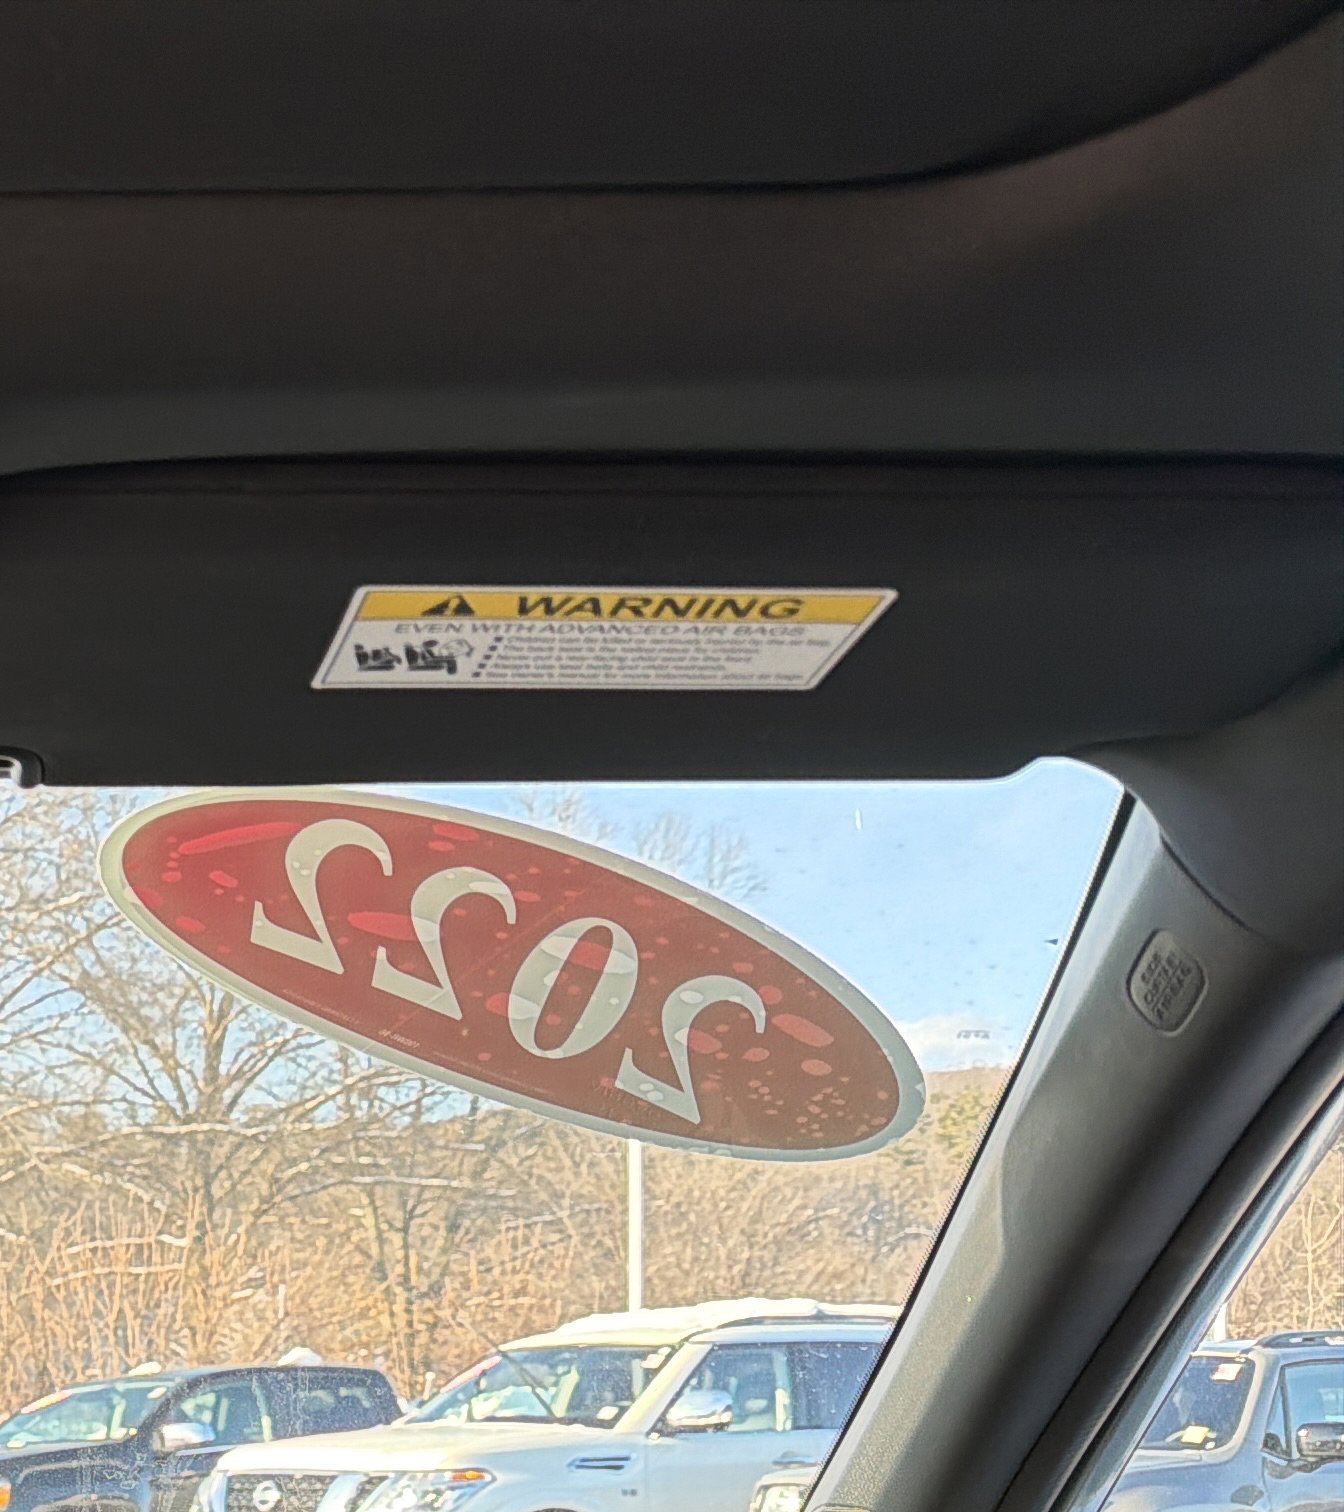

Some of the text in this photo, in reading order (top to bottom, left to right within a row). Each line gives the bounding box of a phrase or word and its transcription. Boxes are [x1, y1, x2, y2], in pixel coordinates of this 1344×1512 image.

[512, 594, 806, 619] WARNING
[394, 623, 806, 637] EVEN WITH ADVANCED AIR BAGS
